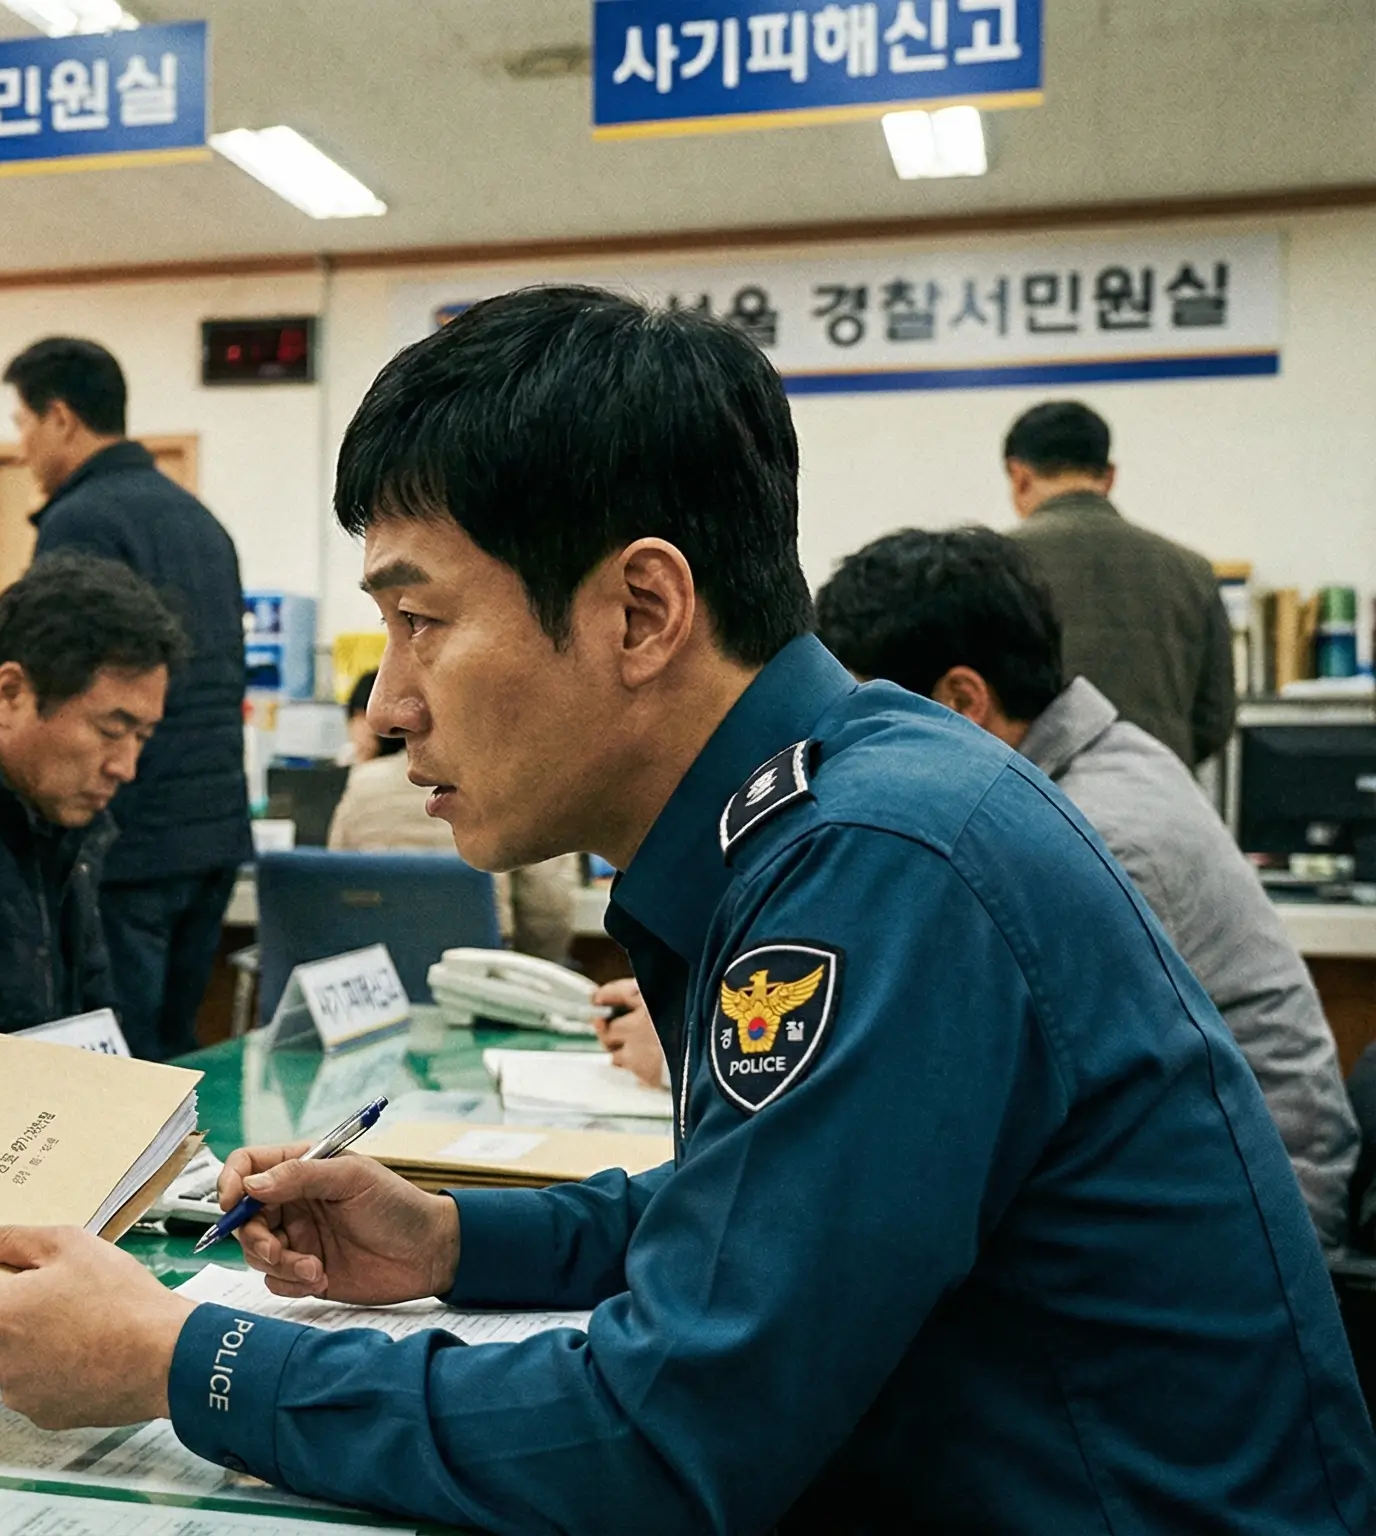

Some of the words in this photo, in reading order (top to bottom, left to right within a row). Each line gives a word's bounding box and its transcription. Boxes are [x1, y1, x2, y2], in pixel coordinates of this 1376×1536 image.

[612, 0, 1022, 94] 사기피해신고
[729, 1055, 786, 1077] POLICE
[209, 1318, 256, 1412] POLICE
